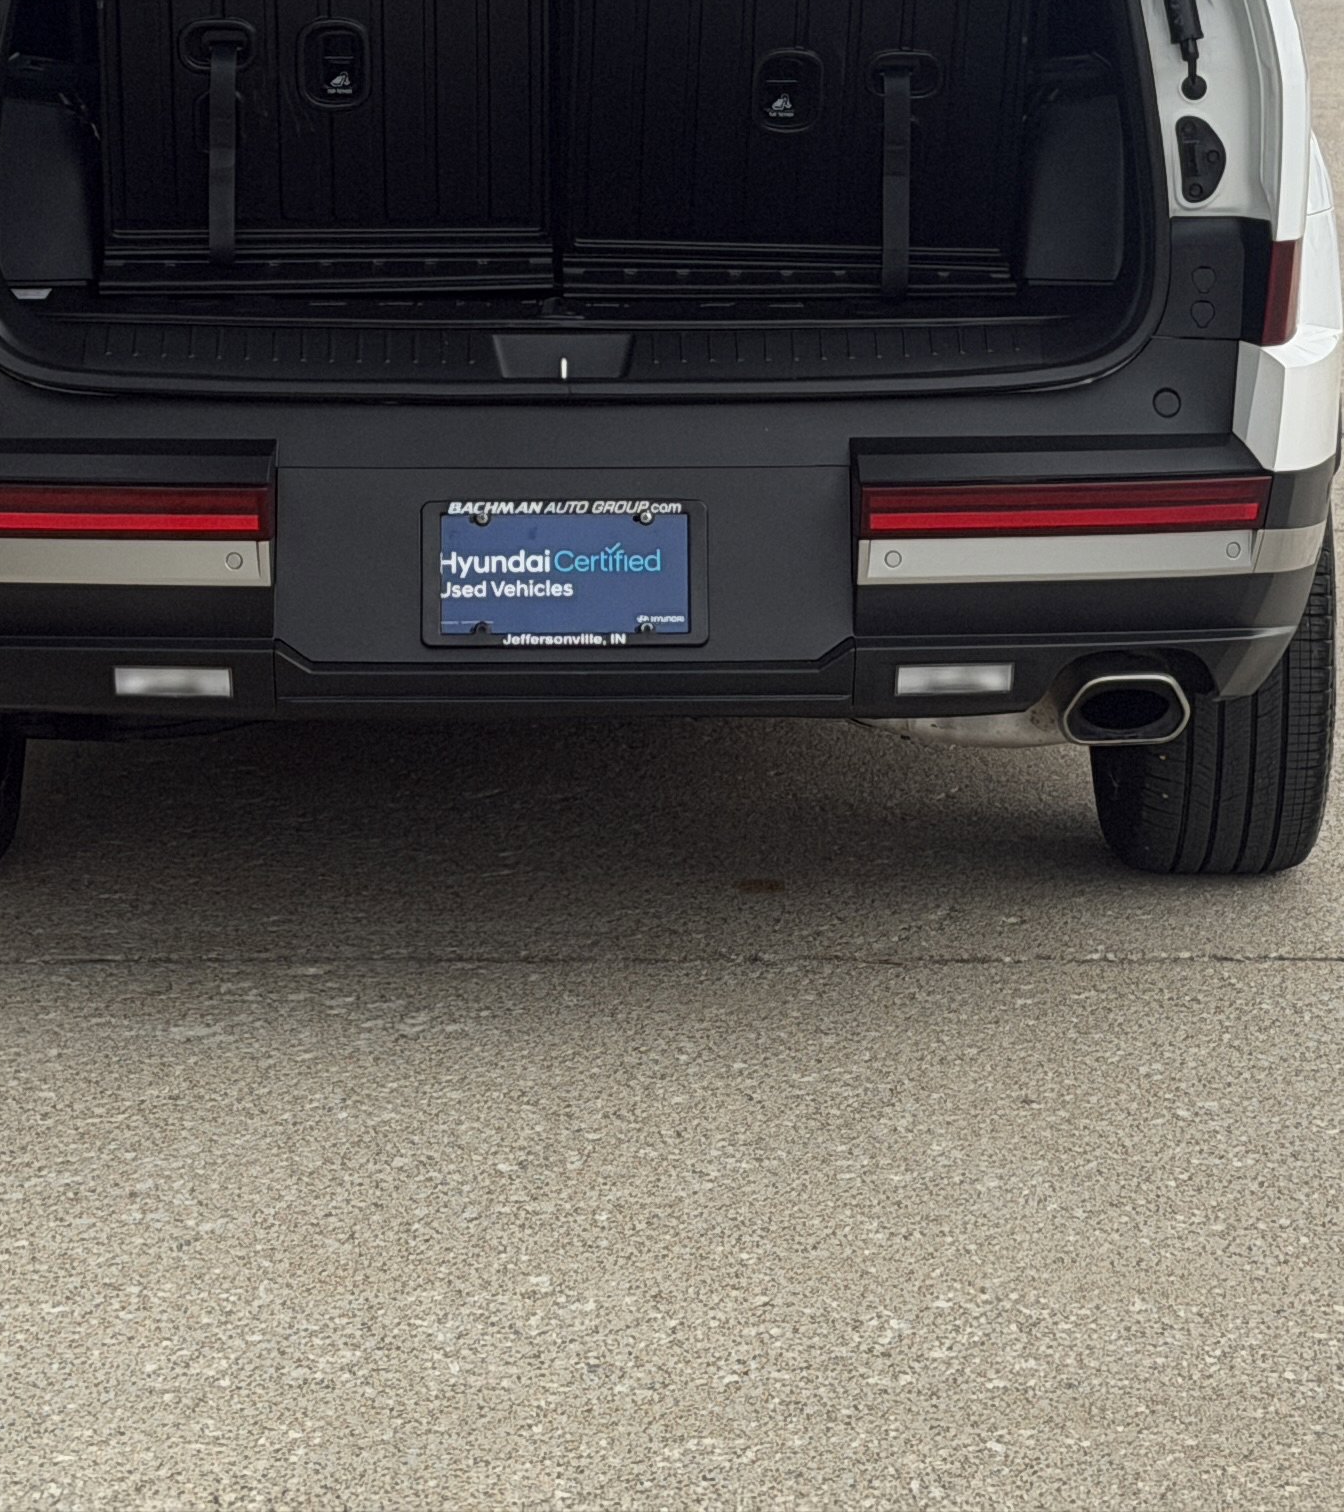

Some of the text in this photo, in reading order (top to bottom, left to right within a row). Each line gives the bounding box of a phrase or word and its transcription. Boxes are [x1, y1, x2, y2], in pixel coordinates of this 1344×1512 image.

[447, 500, 682, 515] BACHMAN AUTO GROUP.com
[439, 543, 661, 579] Hyundai Certified
[490, 579, 574, 598] Vehicles
[502, 632, 627, 646] Jeffersonville, IN
